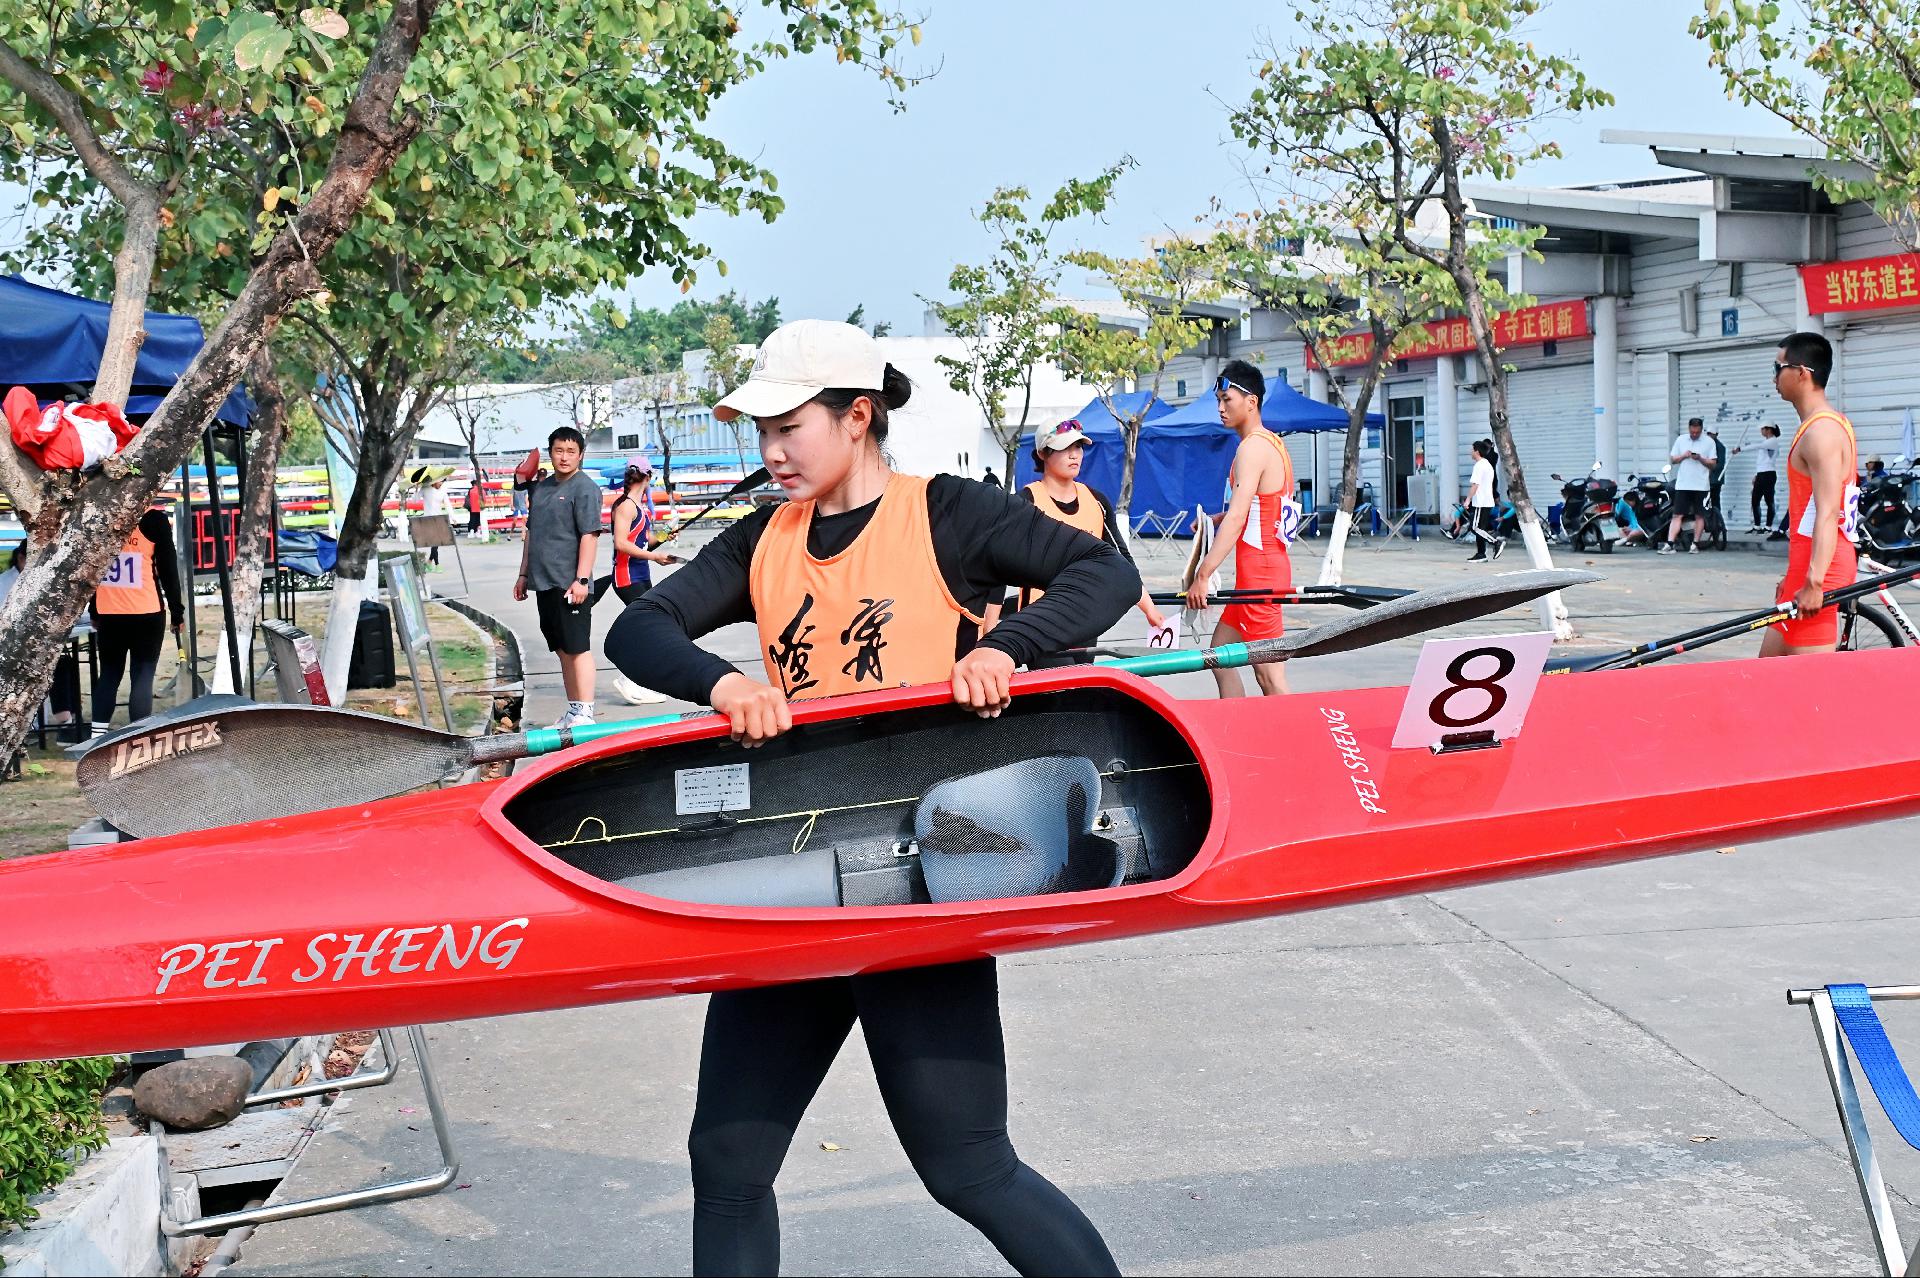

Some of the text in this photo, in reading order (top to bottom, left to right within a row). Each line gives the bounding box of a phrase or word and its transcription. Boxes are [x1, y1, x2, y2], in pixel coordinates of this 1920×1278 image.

[1826, 263, 1918, 304] 当好东道主
[1504, 306, 1573, 342] 守正创新
[1724, 314, 1734, 332] 16
[102, 557, 135, 583] 91
[1150, 627, 1174, 649] 3
[1887, 605, 1919, 641] GIANT
[1428, 646, 1516, 728] 8
[1320, 707, 1387, 814] PEI SHENG
[155, 918, 529, 995] PEI SHENG
